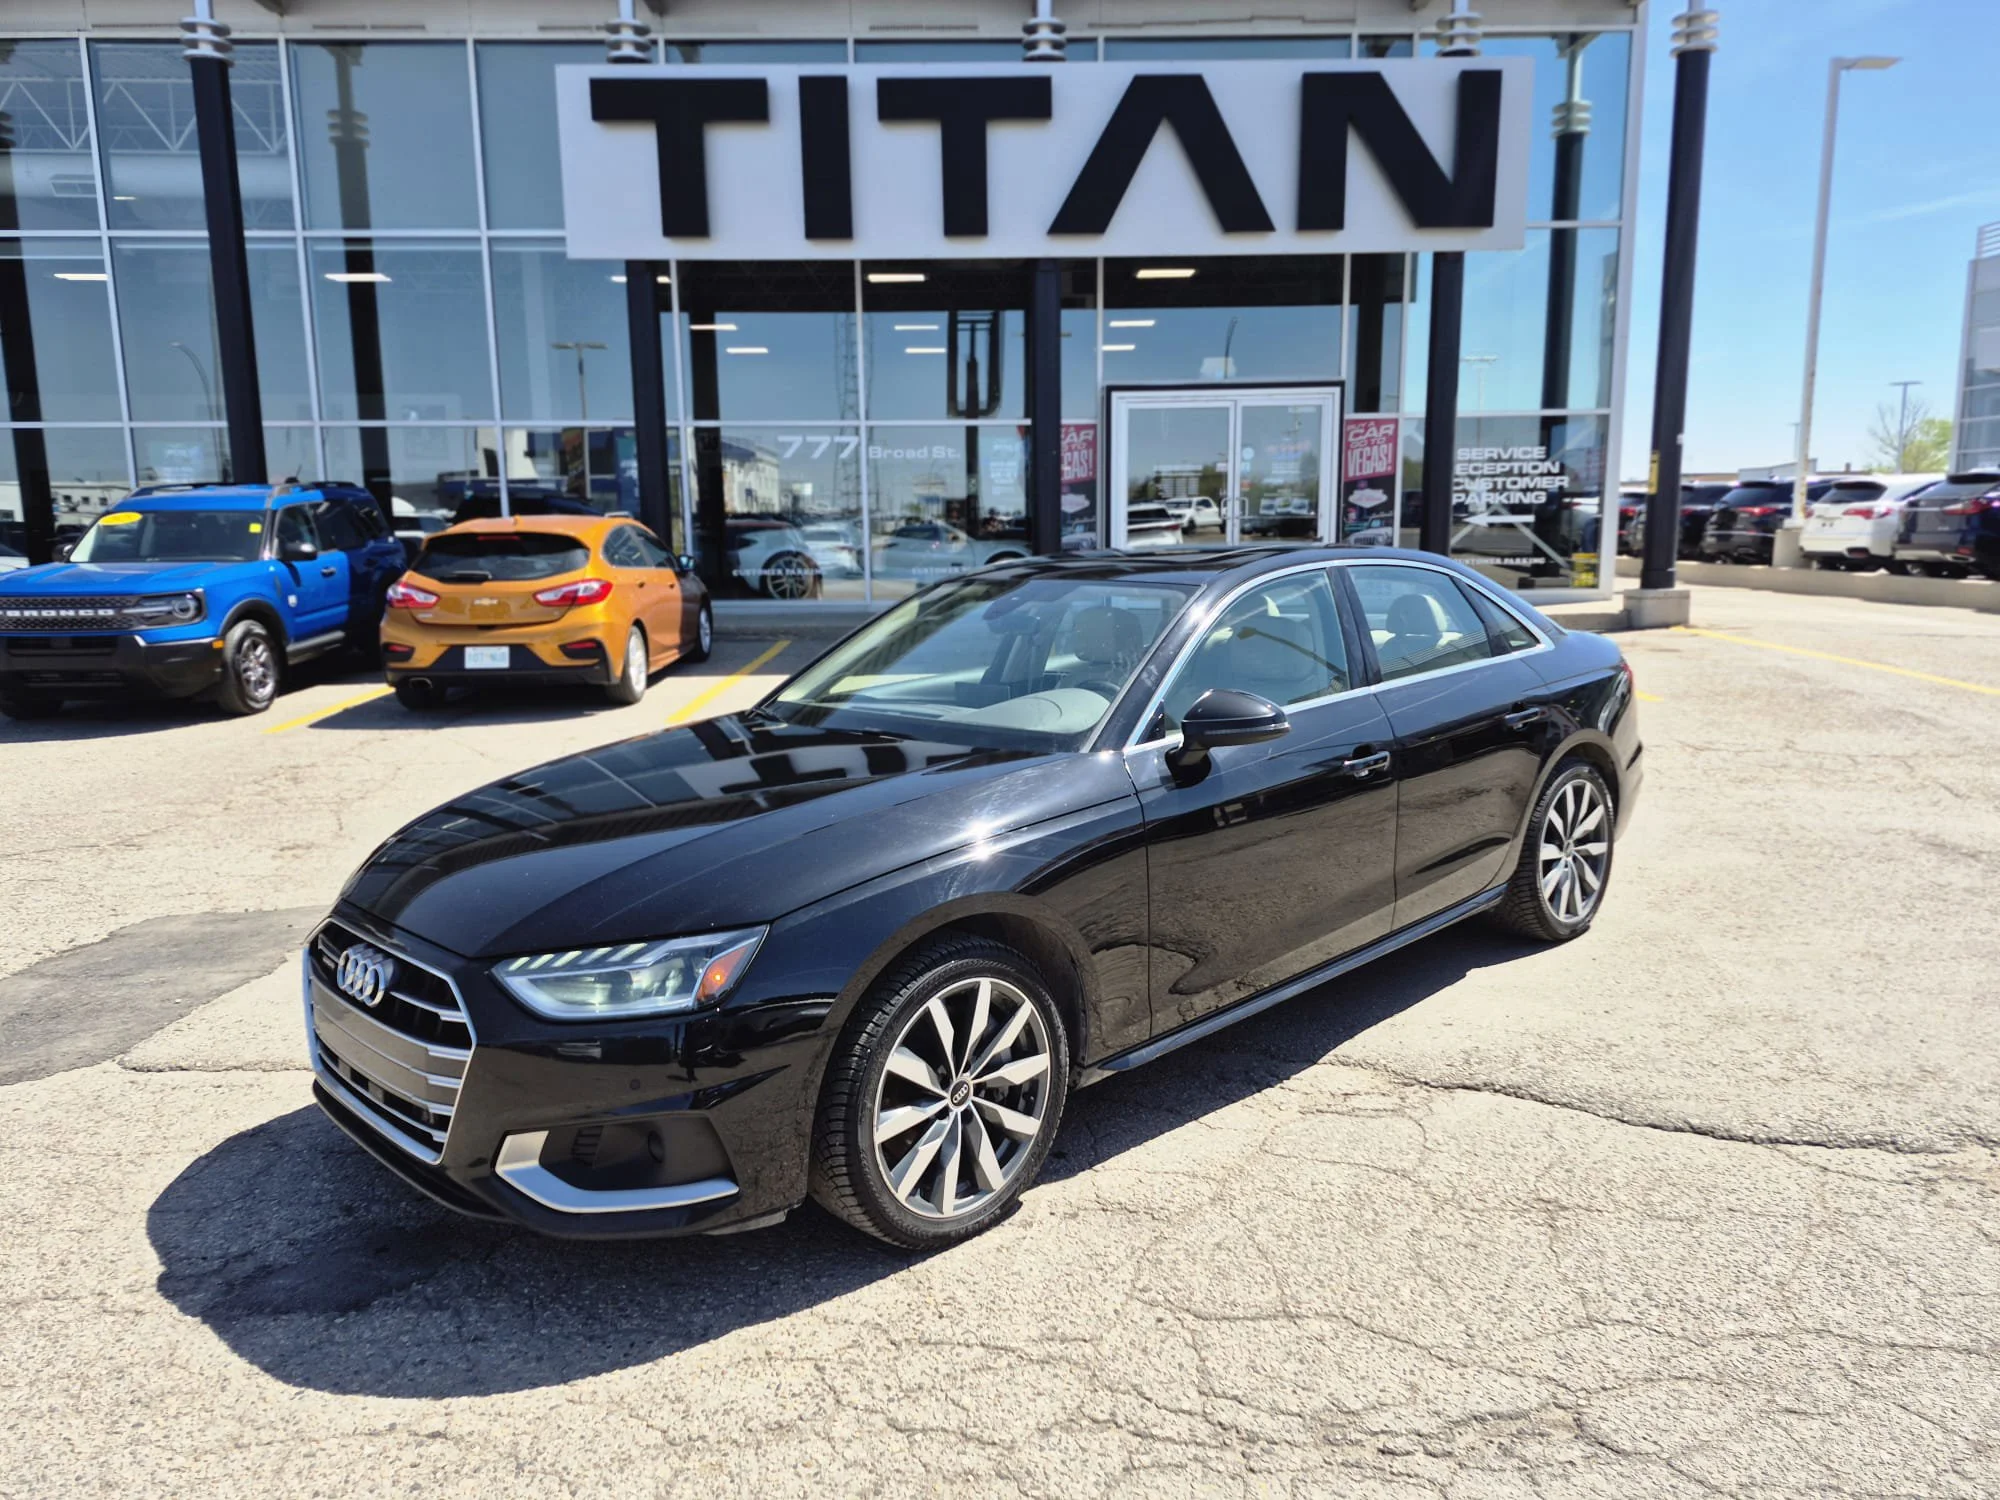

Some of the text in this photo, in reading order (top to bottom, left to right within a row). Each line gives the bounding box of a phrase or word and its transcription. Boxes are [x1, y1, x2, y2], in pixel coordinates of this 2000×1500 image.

[589, 69, 1502, 239] TITAN
[1061, 429, 1095, 444] AR
[1348, 424, 1395, 441] CAR
[777, 435, 961, 459] 777 Broad St.
[1457, 446, 1547, 460] SERVICE
[1061, 448, 1093, 480] GAS!
[1347, 442, 1393, 478] VEGAS!
[1454, 461, 1560, 475] ECEPTION
[1453, 476, 1569, 491] CUSTOMER
[1452, 491, 1547, 505] PARKING
[6, 609, 115, 617] BRONCO
